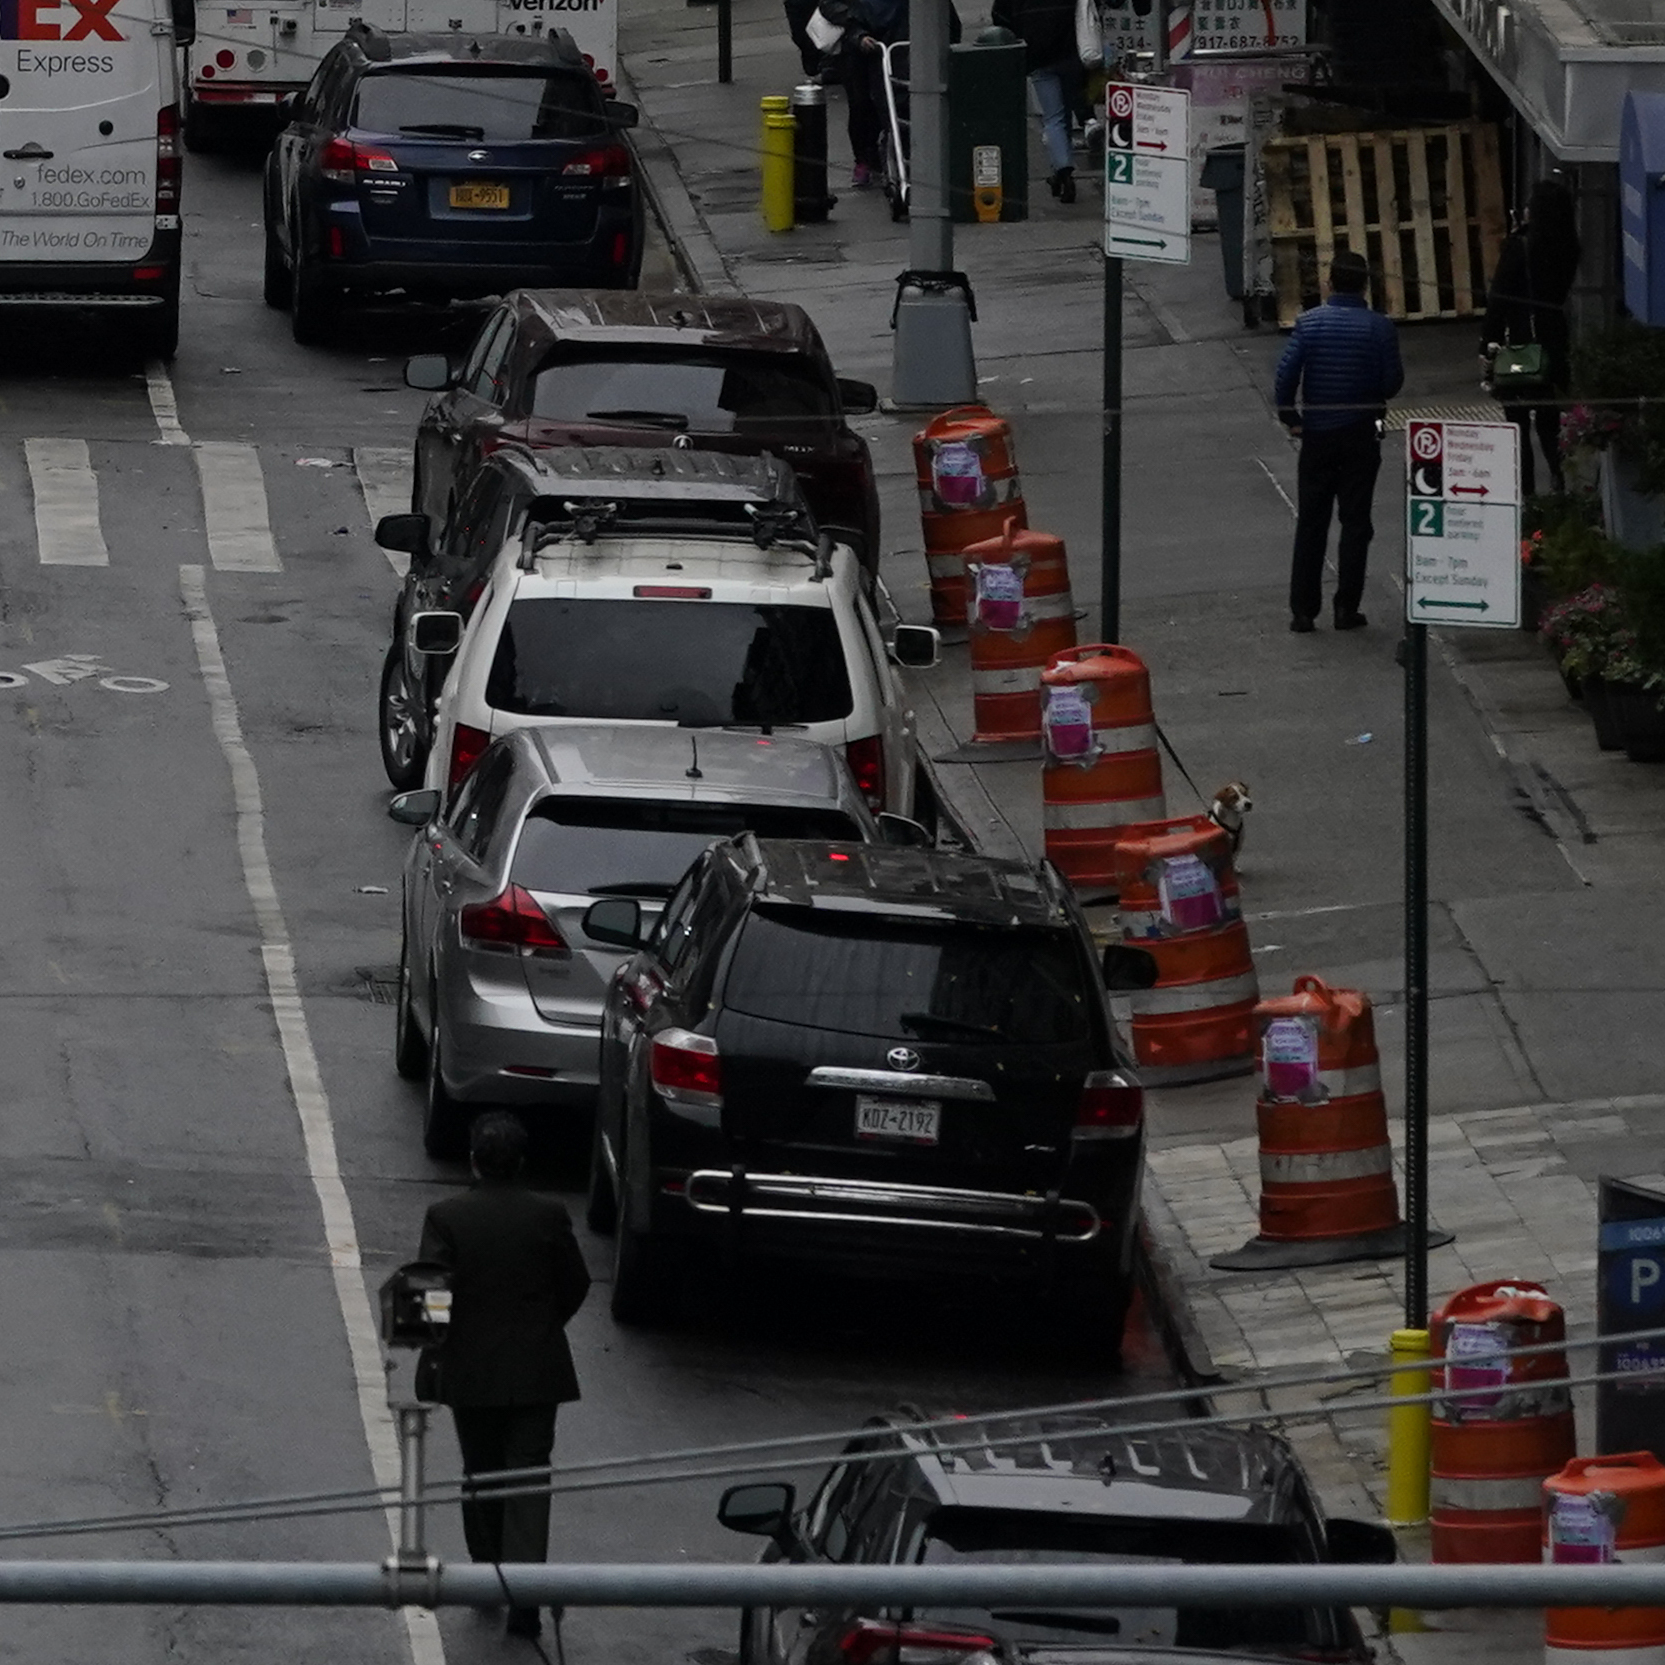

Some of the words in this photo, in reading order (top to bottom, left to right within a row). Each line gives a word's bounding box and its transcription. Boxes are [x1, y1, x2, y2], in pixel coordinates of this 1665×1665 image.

[17, 49, 114, 77] Express
[37, 163, 146, 186] fedex.com
[1113, 154, 1127, 182] 2
[31, 191, 150, 209] 1.800.GoFedEx
[1, 230, 28, 248] The
[30, 230, 80, 249] World
[82, 232, 108, 248] On
[110, 232, 150, 250] Time
[1418, 502, 1436, 535] 2
[1630, 1257, 1662, 1304] P
